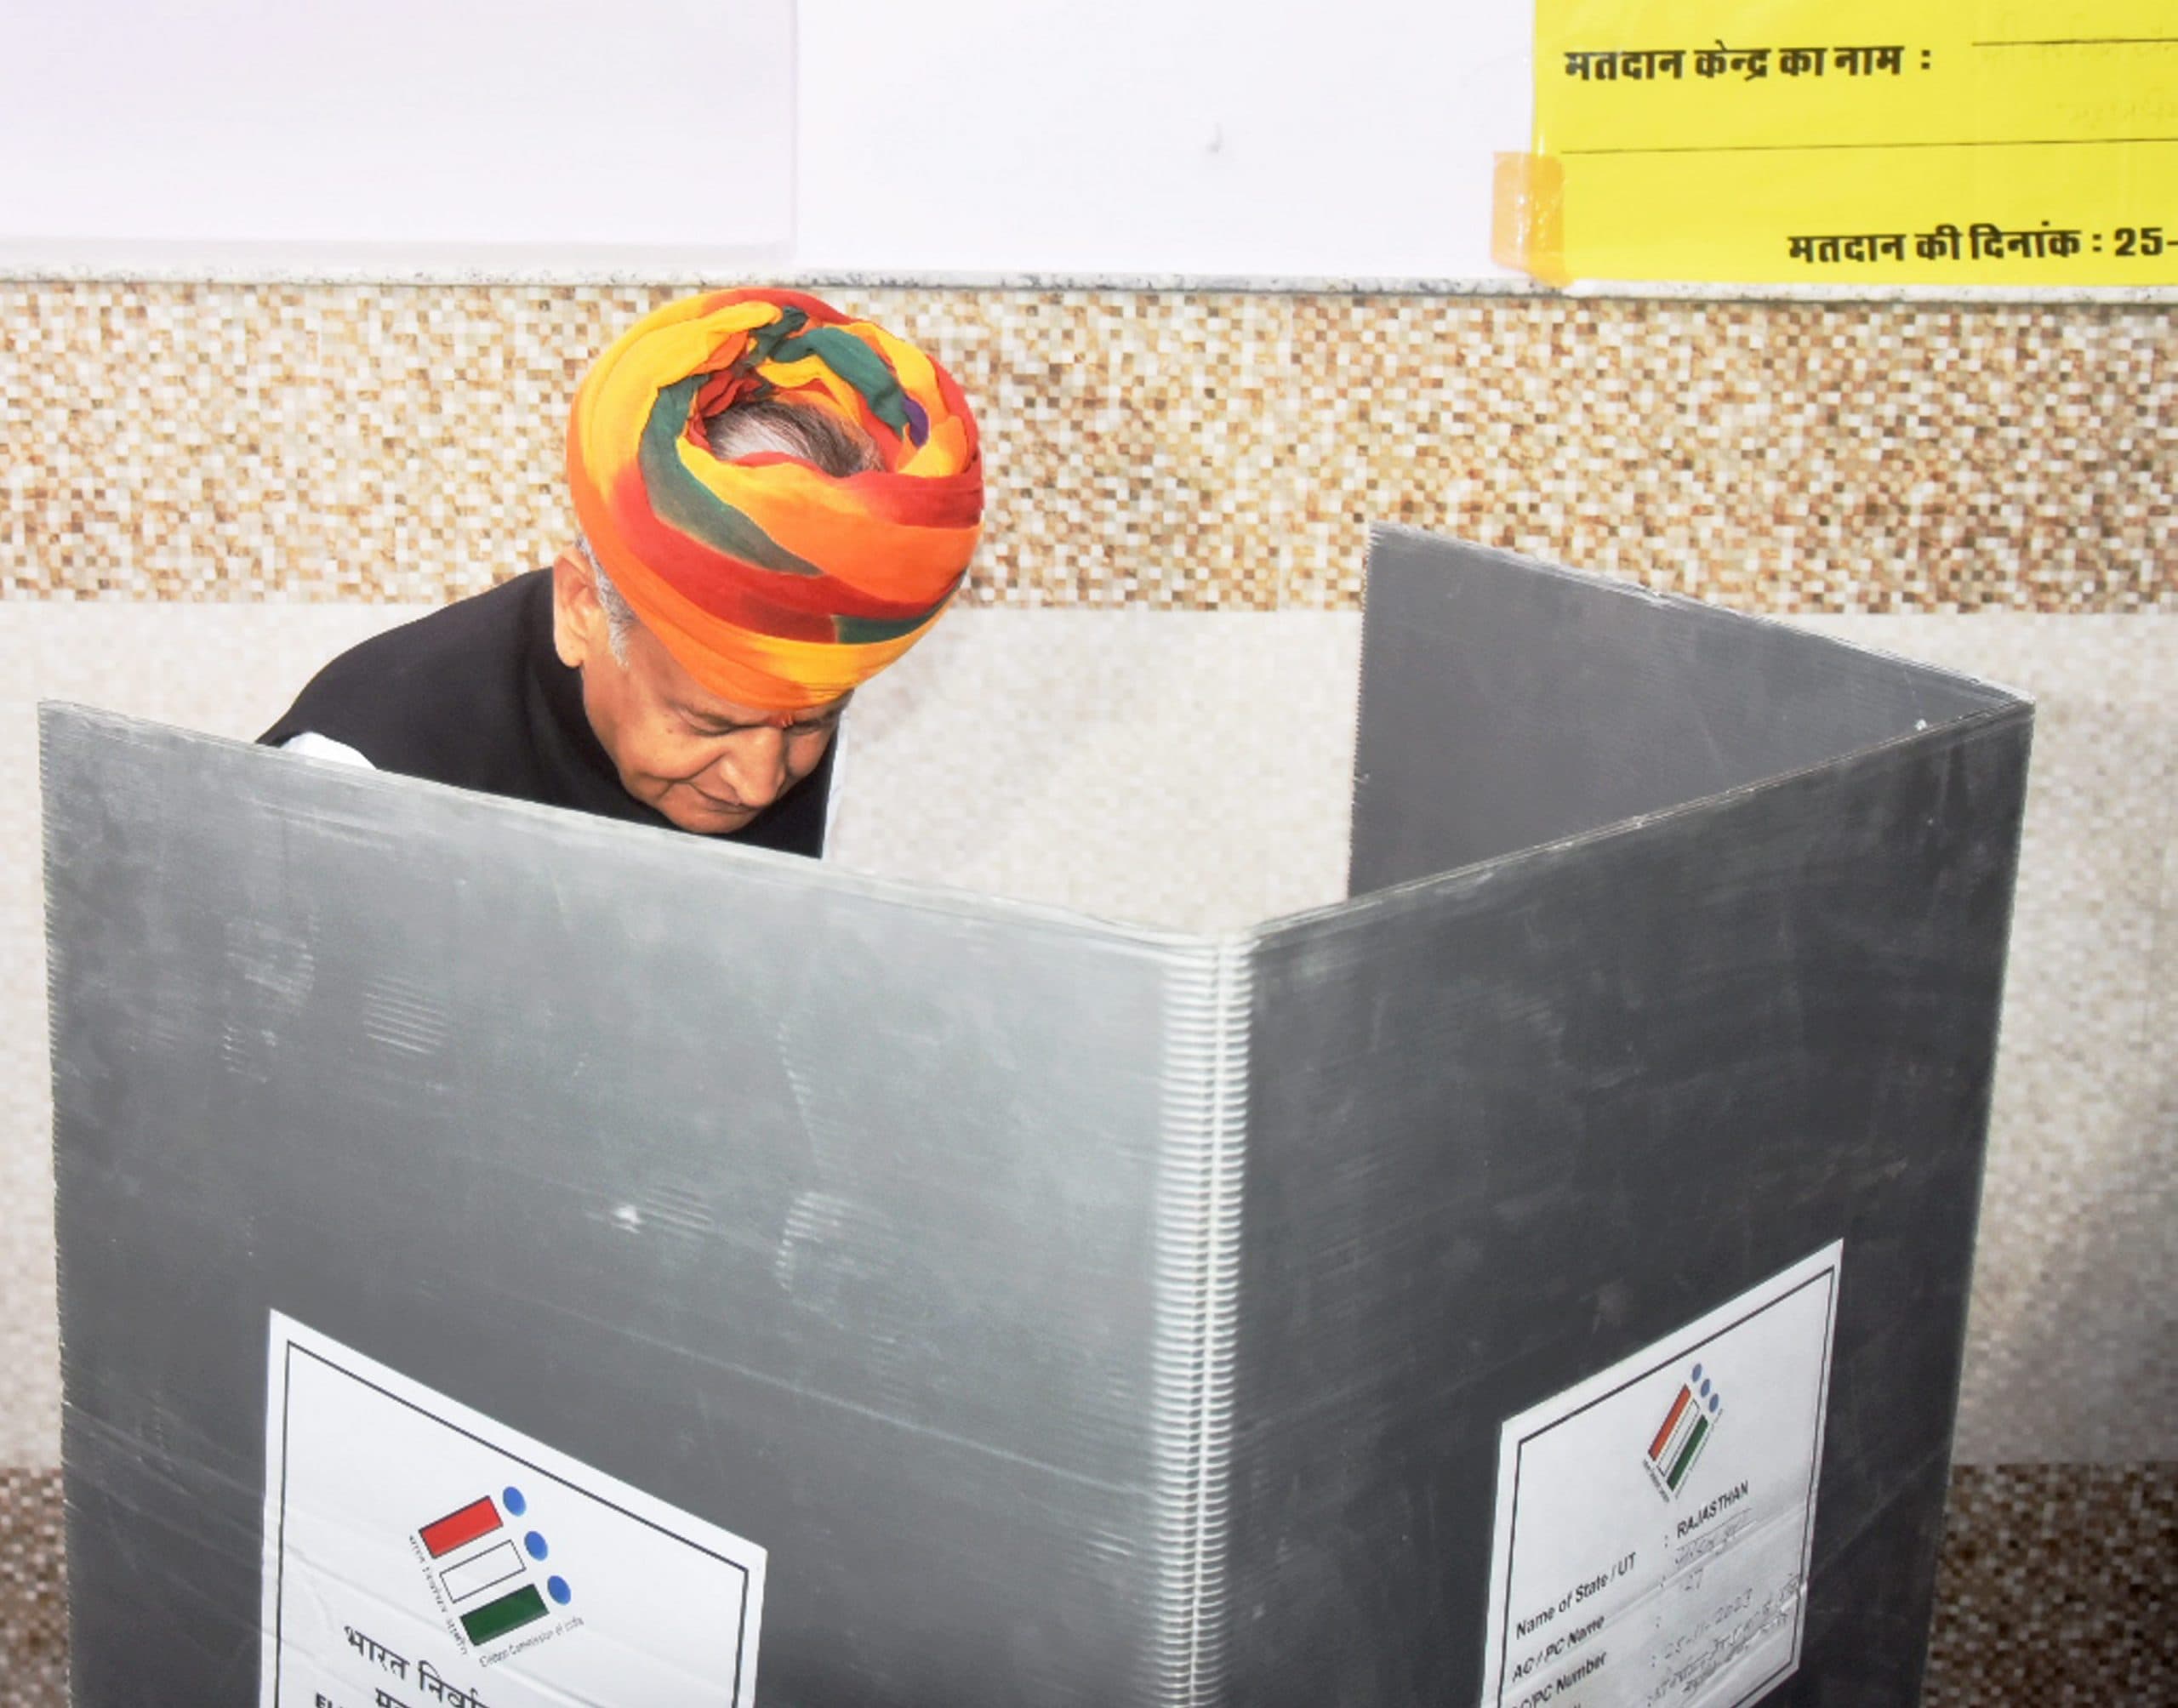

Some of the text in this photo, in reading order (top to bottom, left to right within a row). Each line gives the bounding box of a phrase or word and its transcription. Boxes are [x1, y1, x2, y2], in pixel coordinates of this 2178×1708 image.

[1564, 49, 1686, 81] मतदान
[1694, 39, 1771, 82] केन्द्र
[1779, 47, 1827, 77] का
[1833, 45, 1905, 77] नाम
[1787, 234, 1907, 264] मतदान
[1914, 224, 1963, 261] की
[1969, 220, 2082, 260] दिनांक
[1516, 1607, 1555, 1640] Name
[1559, 1591, 1573, 1613] of
[1575, 1573, 1609, 1603] State
[1617, 1551, 1636, 1576] UT
[1676, 1480, 1749, 1538] RAJASTHAN
[344, 1625, 410, 1680] भारत
[1567, 1615, 1605, 1648] Name
[1556, 1652, 1606, 1694] Number
